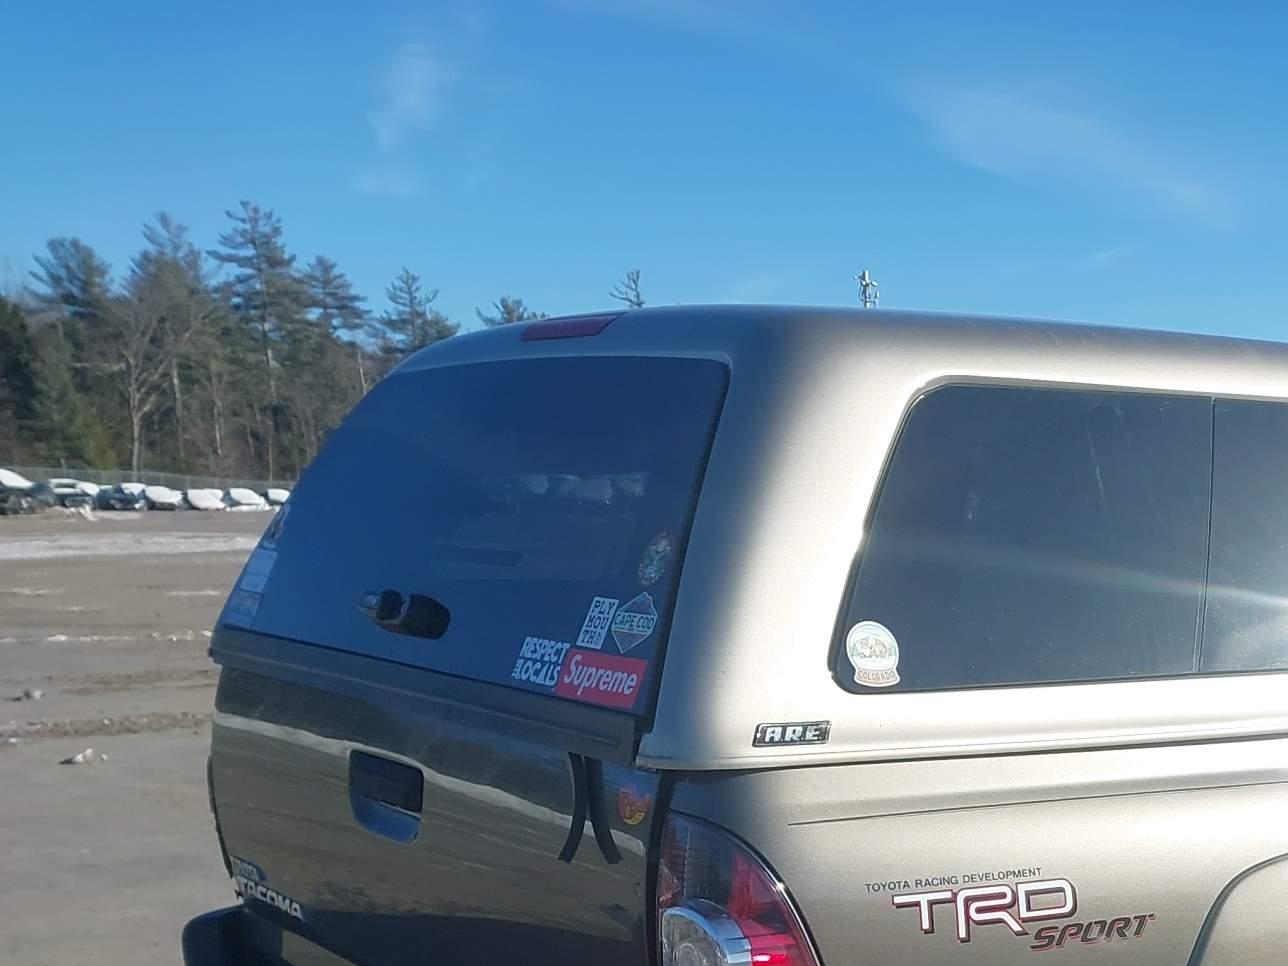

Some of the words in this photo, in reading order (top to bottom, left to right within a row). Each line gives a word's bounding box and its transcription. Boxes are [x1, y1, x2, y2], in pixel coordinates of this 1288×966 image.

[591, 600, 616, 616] PLY
[614, 613, 635, 628] CAPE
[636, 616, 656, 630] COD
[520, 636, 570, 664] RESPECT
[514, 659, 561, 686] LOCALS
[563, 654, 638, 696] Supreme
[858, 669, 897, 682] COLORADO
[864, 878, 911, 894] TOYOTA
[914, 875, 960, 889] RACING
[962, 867, 1043, 885] DEVELOPMENT
[236, 874, 305, 922] TACOMA
[891, 877, 1077, 944] TRD
[1029, 913, 1158, 951] SPORT
